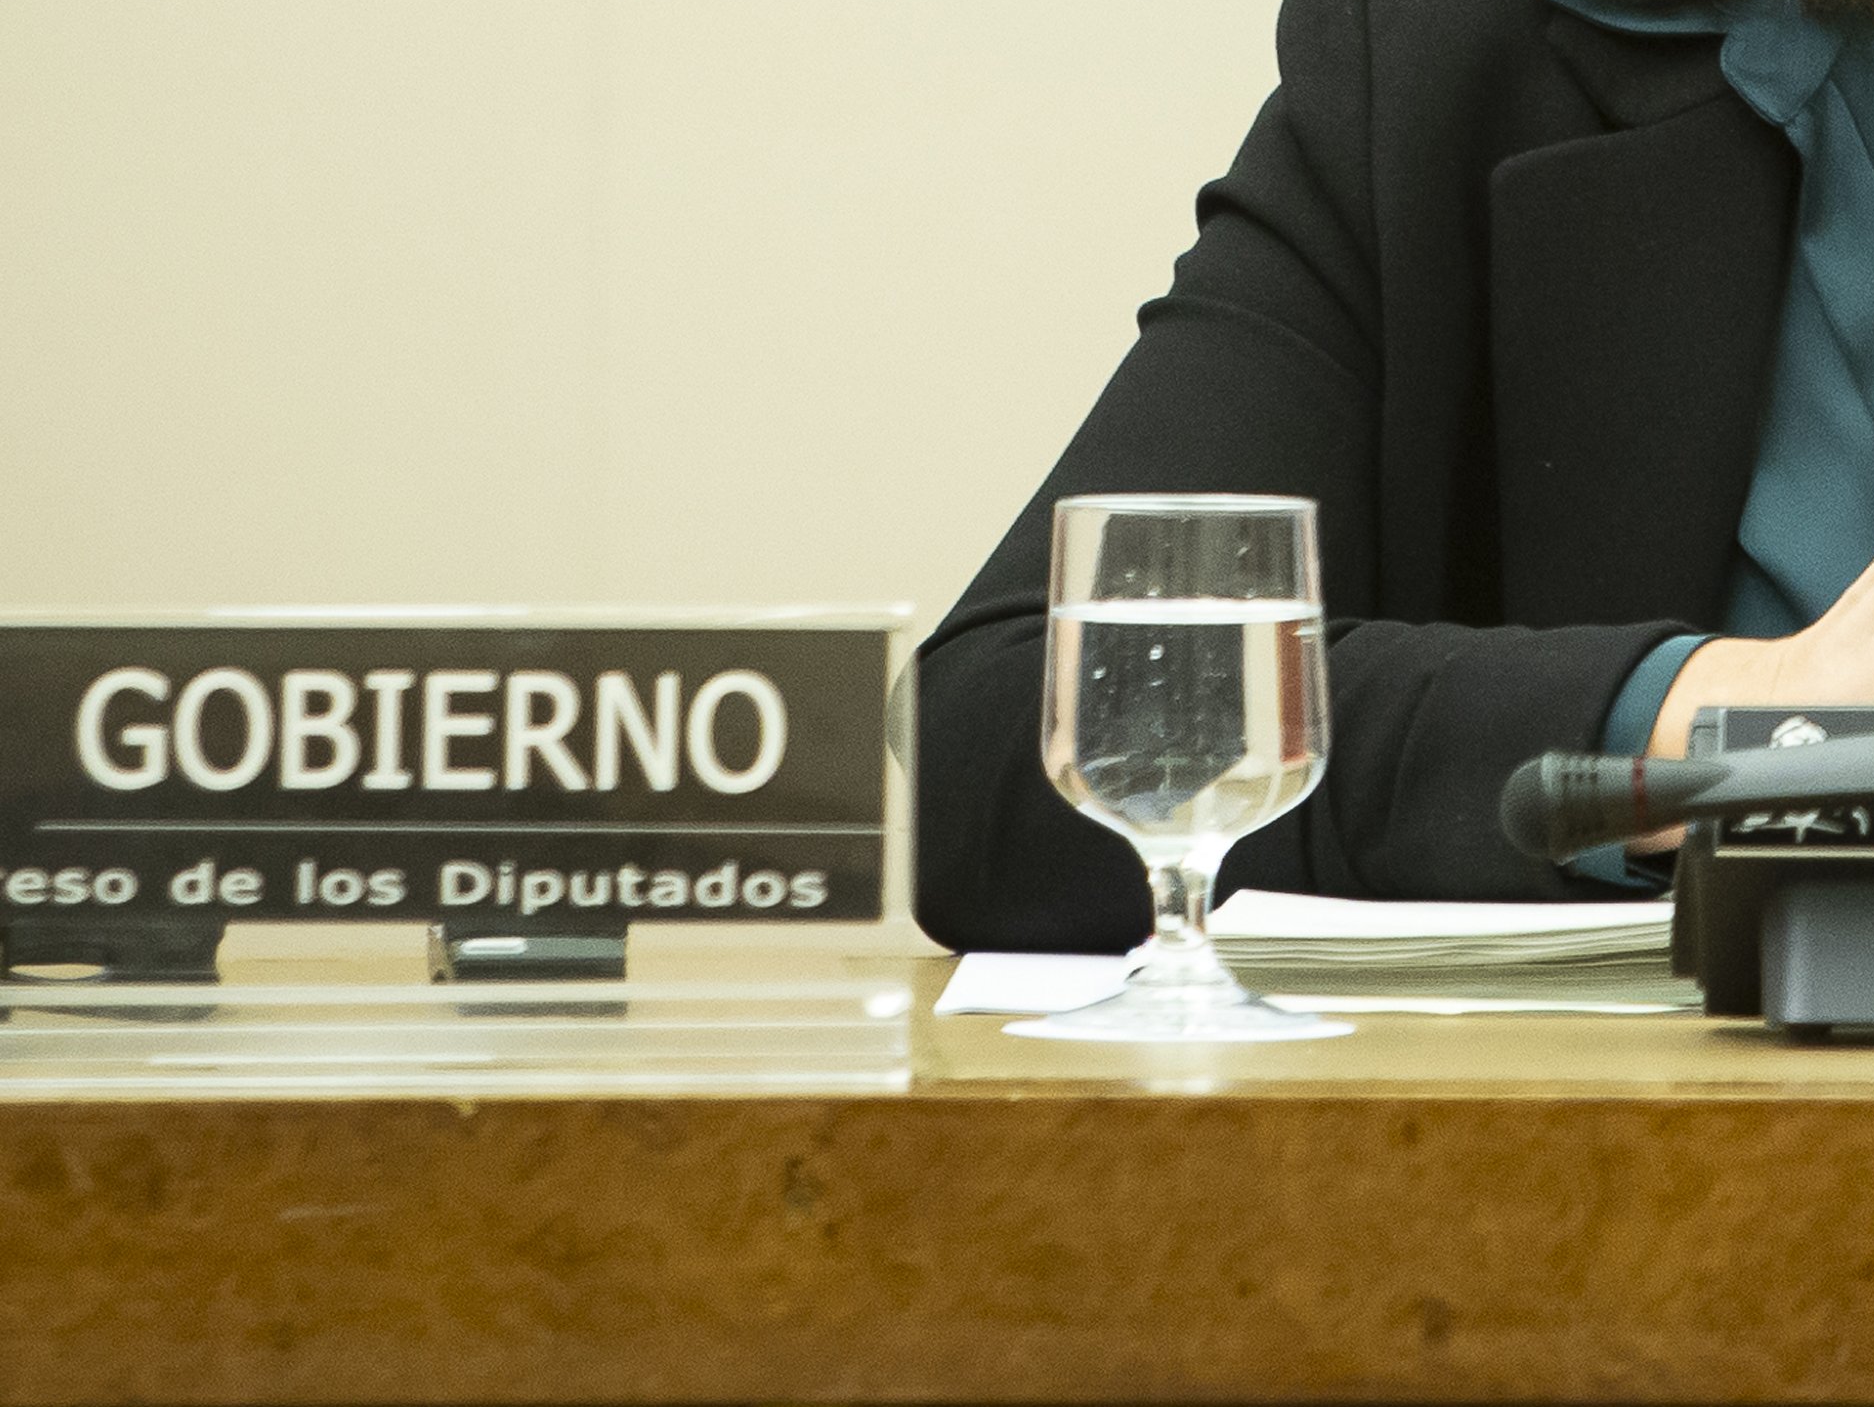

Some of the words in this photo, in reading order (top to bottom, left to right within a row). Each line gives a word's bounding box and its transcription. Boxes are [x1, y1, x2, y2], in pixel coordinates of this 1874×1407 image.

[75, 667, 789, 794] GOBIERNO
[0, 867, 139, 906] eso
[169, 858, 264, 906] de
[296, 859, 406, 906] los
[439, 859, 829, 915] Diputados
